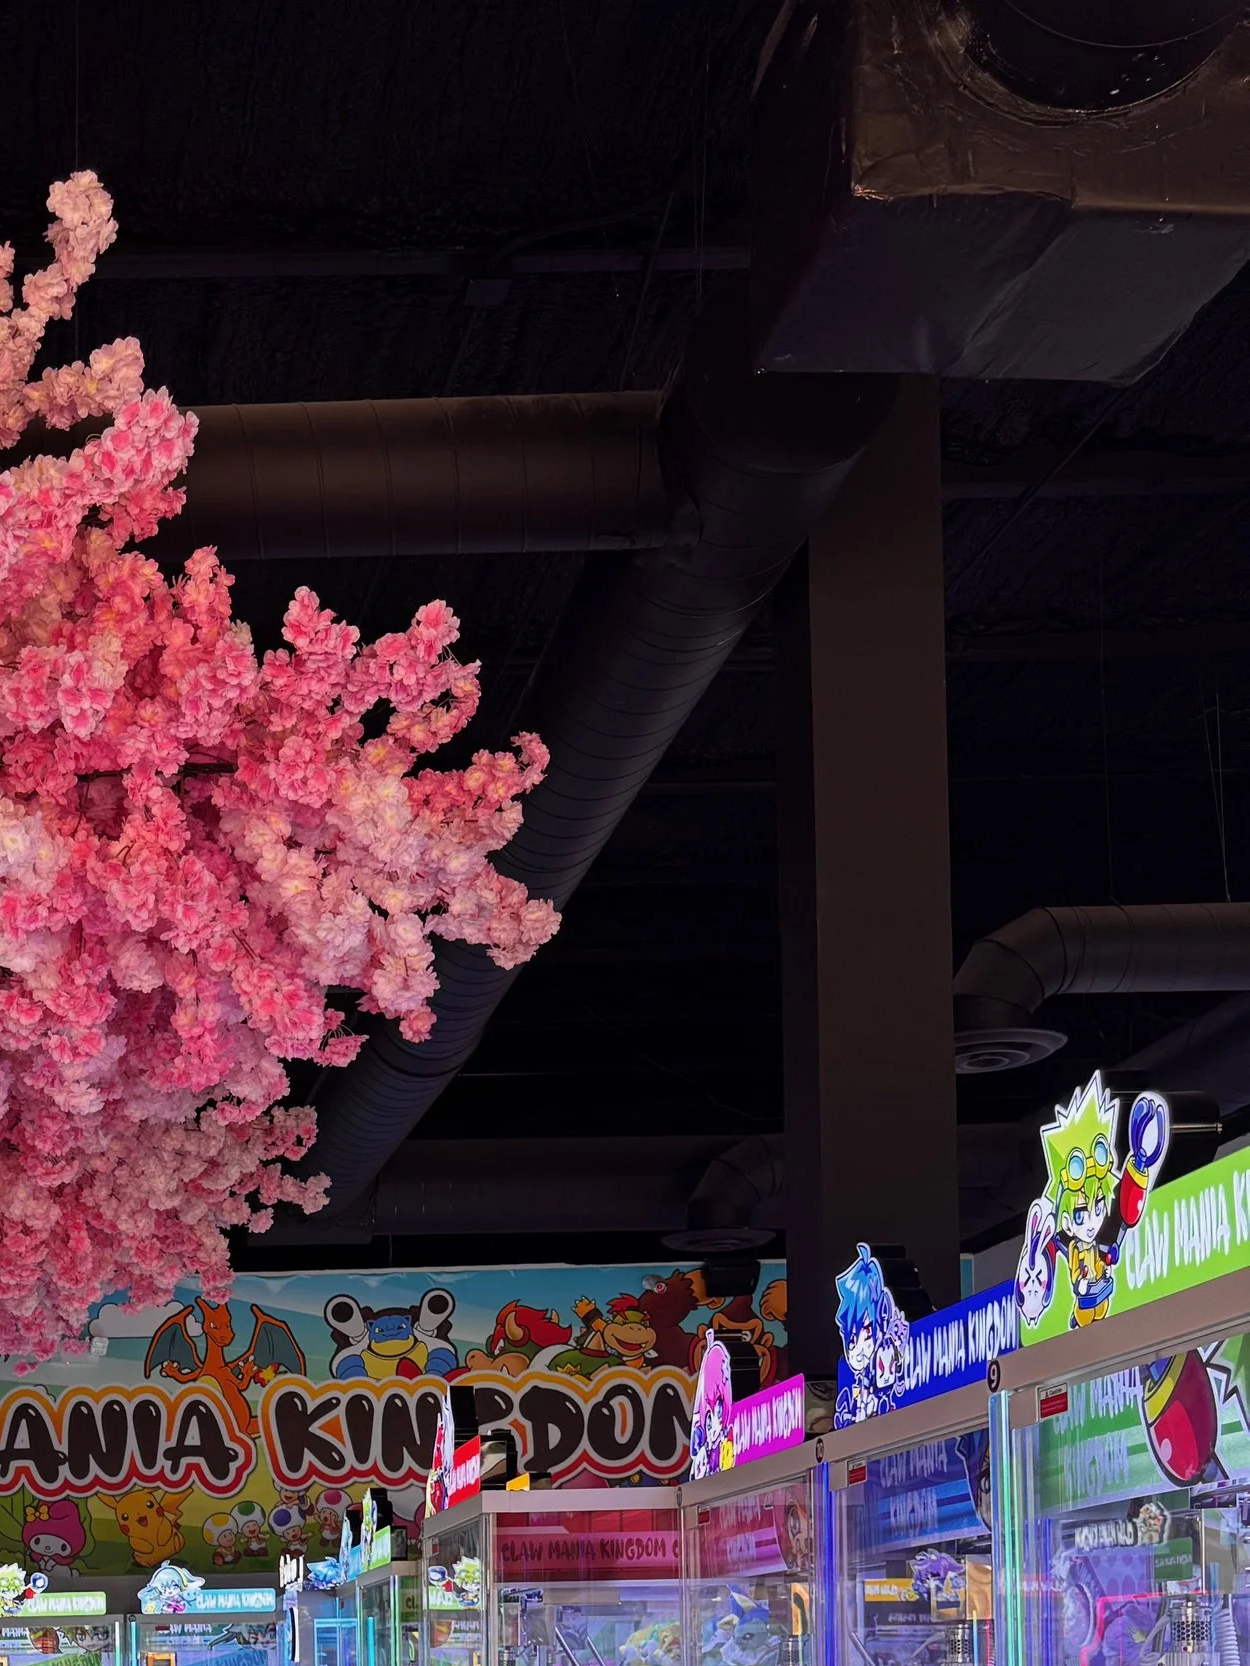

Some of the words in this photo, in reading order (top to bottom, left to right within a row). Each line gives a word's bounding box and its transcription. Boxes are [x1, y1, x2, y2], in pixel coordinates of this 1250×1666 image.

[1125, 1208, 1169, 1290] CLAW
[1174, 1183, 1231, 1270] MANIA
[903, 1331, 931, 1391] CLAW
[933, 1318, 966, 1379] MANIA
[967, 1293, 1017, 1366] KINGDOM
[752, 1401, 771, 1447] MANIA
[772, 1388, 801, 1440] KINGDOM
[910, 1439, 949, 1478] MANIA
[501, 1540, 543, 1562] CLAW
[548, 1538, 596, 1561] MANIA
[600, 1536, 666, 1561] KINGDOM
